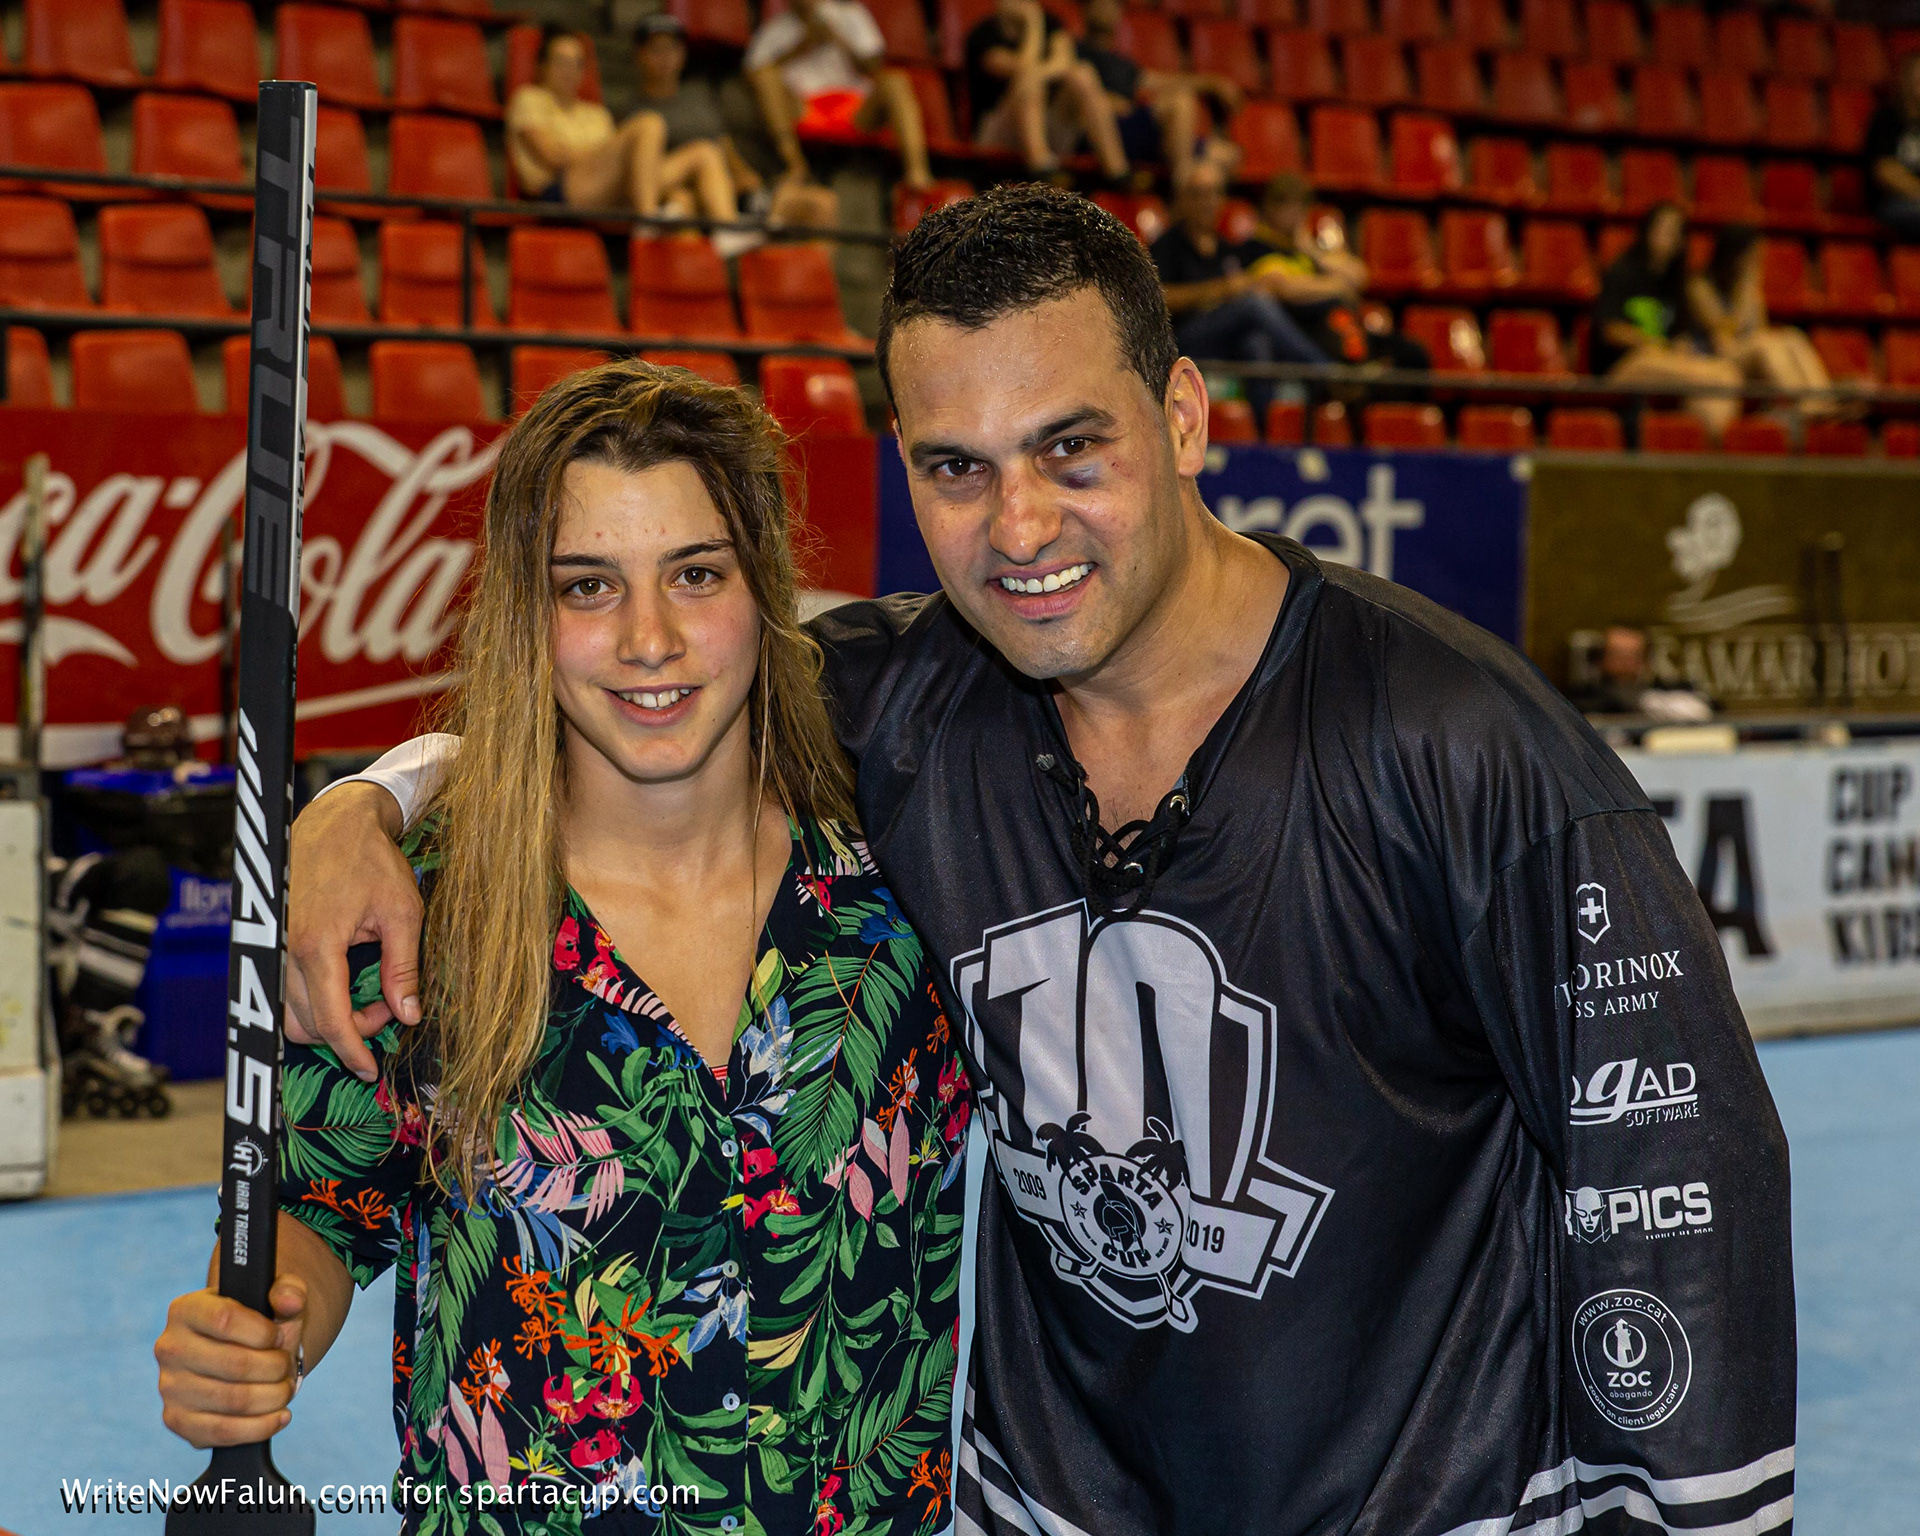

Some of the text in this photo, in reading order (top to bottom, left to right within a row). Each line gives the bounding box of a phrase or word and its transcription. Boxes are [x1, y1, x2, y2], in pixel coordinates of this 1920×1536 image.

[247, 115, 300, 608] TRUE
[1603, 991, 1660, 1016] ARMY
[1625, 1101, 1700, 1128] SOFTWARE
[1012, 1167, 1047, 1200] 2009
[1071, 1163, 1164, 1211] SPARTA
[232, 1180, 251, 1267] HAIR TRIGGER
[1185, 1214, 1226, 1254] 019
[1101, 1242, 1152, 1269] CUP
[1578, 1296, 1669, 1327] www.zoc.cat
[1617, 1415, 1646, 1426] client
[1645, 1402, 1668, 1423] legal
[1665, 1382, 1680, 1404] care
